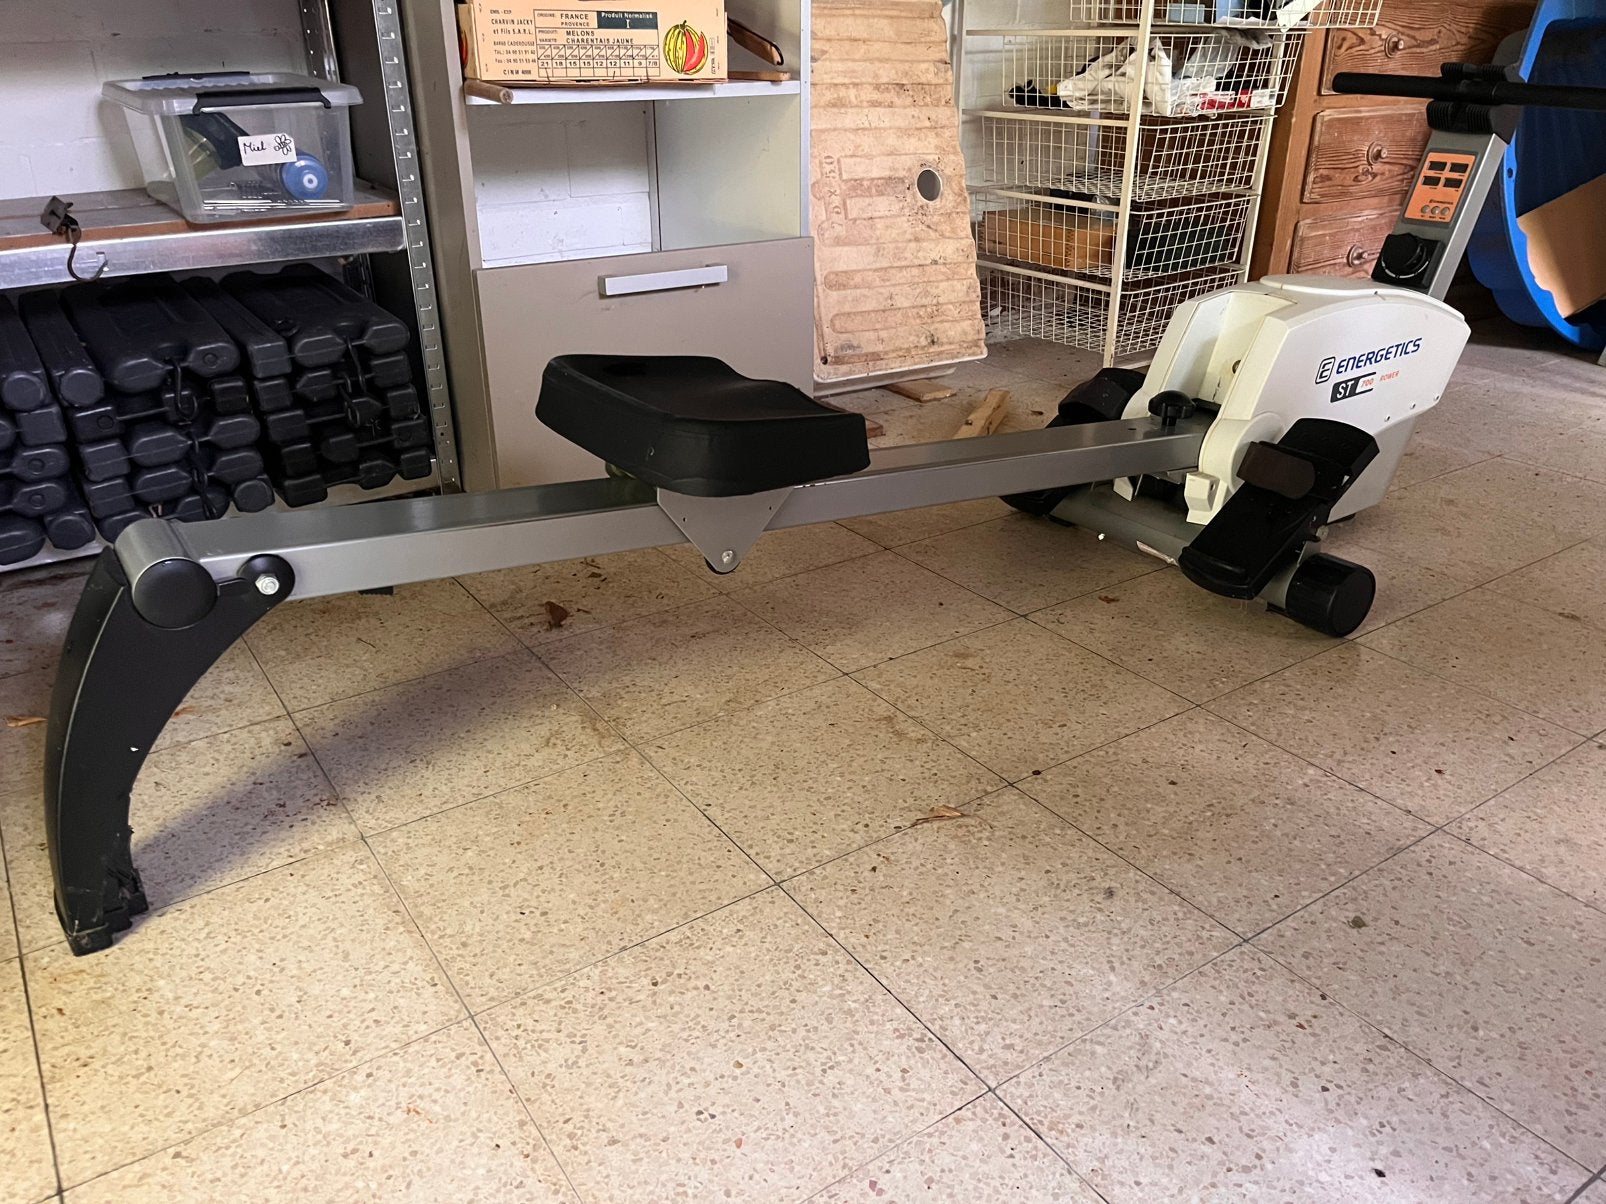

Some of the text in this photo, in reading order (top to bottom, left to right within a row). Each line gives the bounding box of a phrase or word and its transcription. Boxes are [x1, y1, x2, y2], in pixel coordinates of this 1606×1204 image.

[243, 140, 266, 154] Miel
[1336, 337, 1422, 374] ENERGETICS
[1336, 370, 1400, 399] ST 700 POWER
